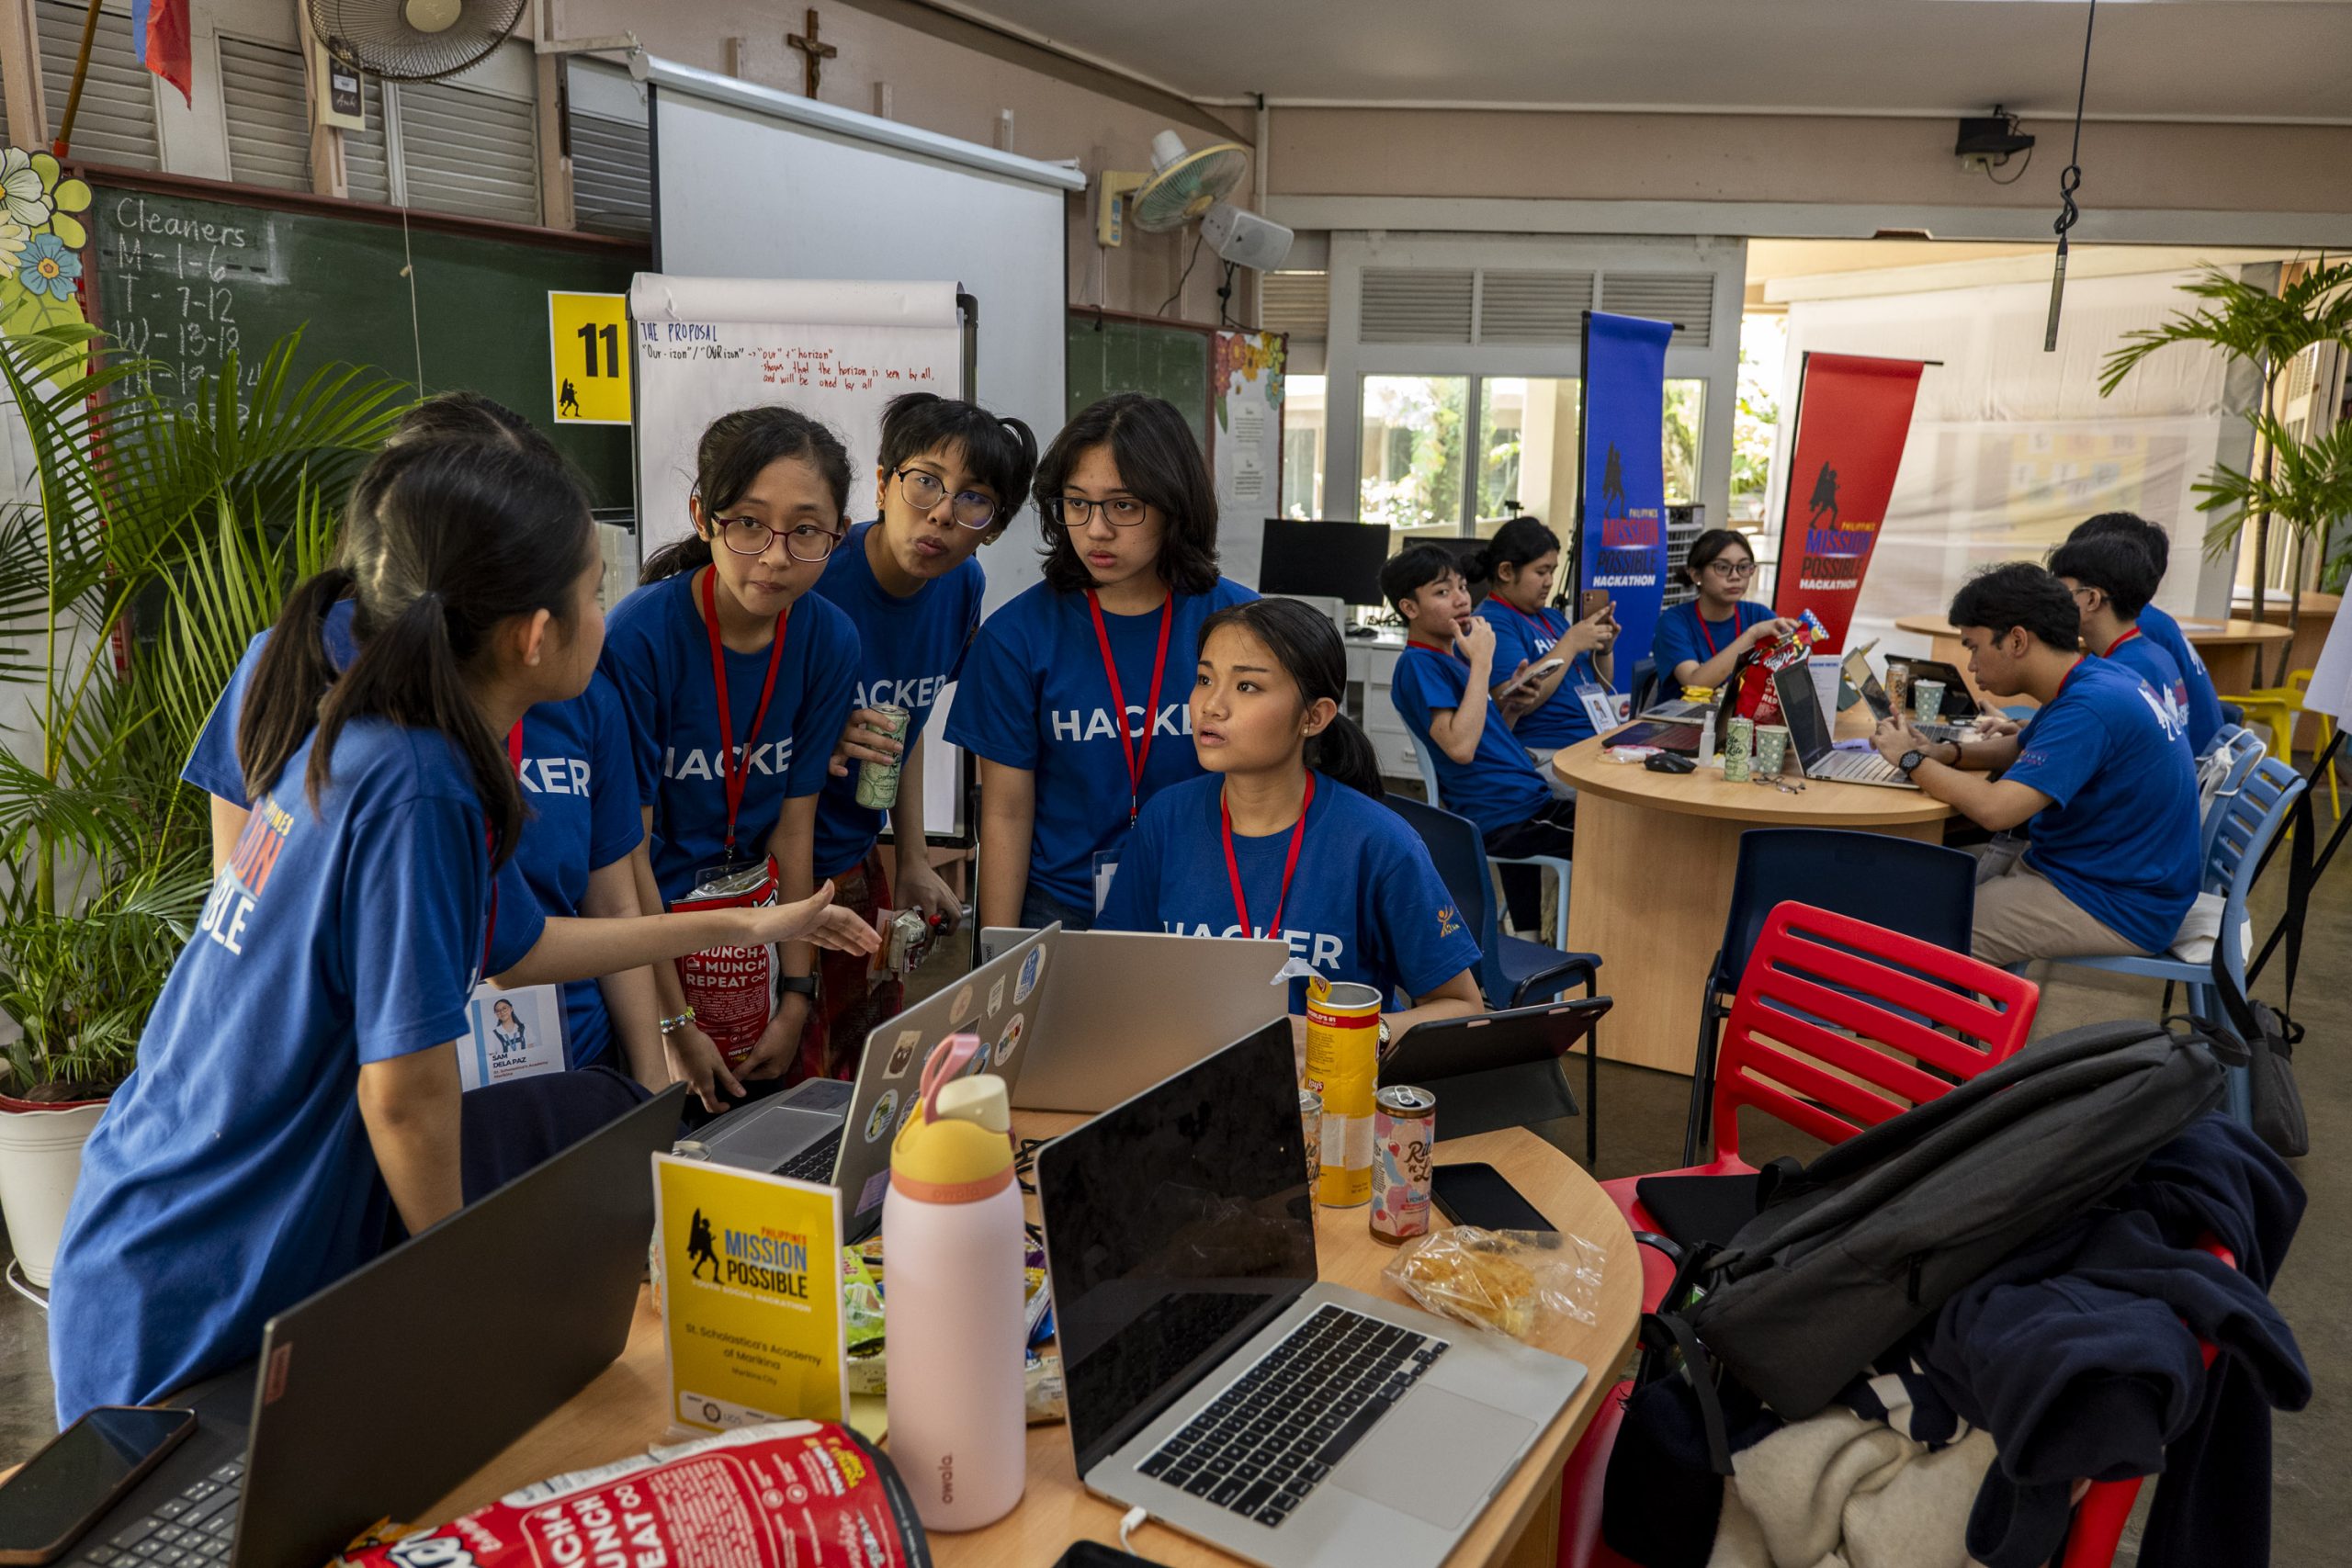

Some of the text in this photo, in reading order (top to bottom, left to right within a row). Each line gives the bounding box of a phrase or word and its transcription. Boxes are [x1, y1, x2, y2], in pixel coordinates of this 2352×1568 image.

[117, 197, 246, 248] Cleaners
[640, 322, 718, 343] THE PROPOSAL
[577, 321, 619, 378] 11
[763, 372, 775, 383] and
[779, 373, 795, 384] will
[798, 374, 809, 386] be
[845, 378, 854, 391] by
[862, 378, 873, 389] all
[793, 361, 809, 374] that
[818, 361, 831, 375] the
[838, 360, 867, 377] horizon
[909, 367, 918, 382] by
[1601, 518, 1659, 547] MISSION
[1804, 528, 1872, 555] MISSION
[1595, 549, 1659, 574] POSSIBLE
[1800, 556, 1863, 580] POSSIBLE
[1592, 574, 1657, 588] HACKATHON
[1799, 578, 1859, 591] HACKATHON
[705, 957, 767, 974] MUNCH
[685, 974, 749, 988] REPEAT
[492, 1053, 509, 1062] SAM
[492, 1056, 527, 1069] DELA PAZ
[724, 1228, 808, 1273] MISSION
[727, 1258, 809, 1300] POSSIBLE
[723, 1348, 781, 1371] of Marikina
[770, 1344, 822, 1368] Academy
